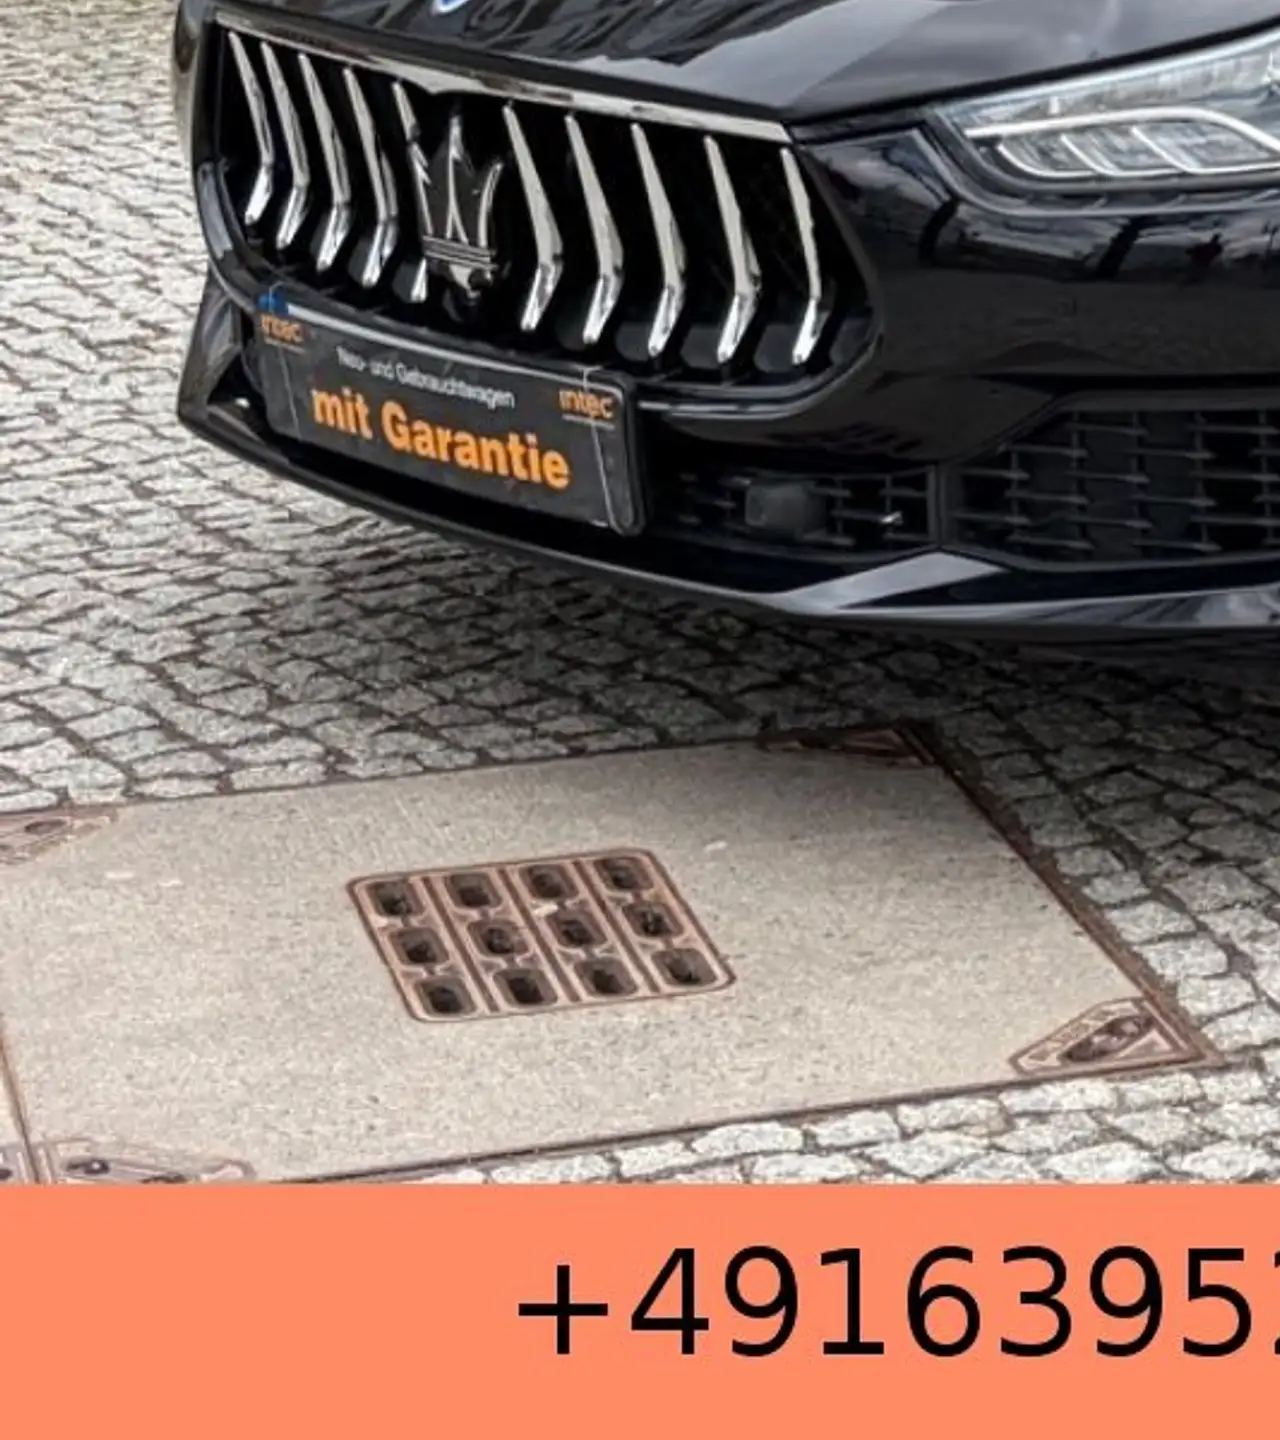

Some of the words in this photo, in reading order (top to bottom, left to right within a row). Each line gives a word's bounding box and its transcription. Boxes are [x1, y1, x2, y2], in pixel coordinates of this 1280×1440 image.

[396, 362, 515, 410] Gebrauchtwagen
[311, 384, 374, 440] mit
[380, 399, 571, 490] Garantie
